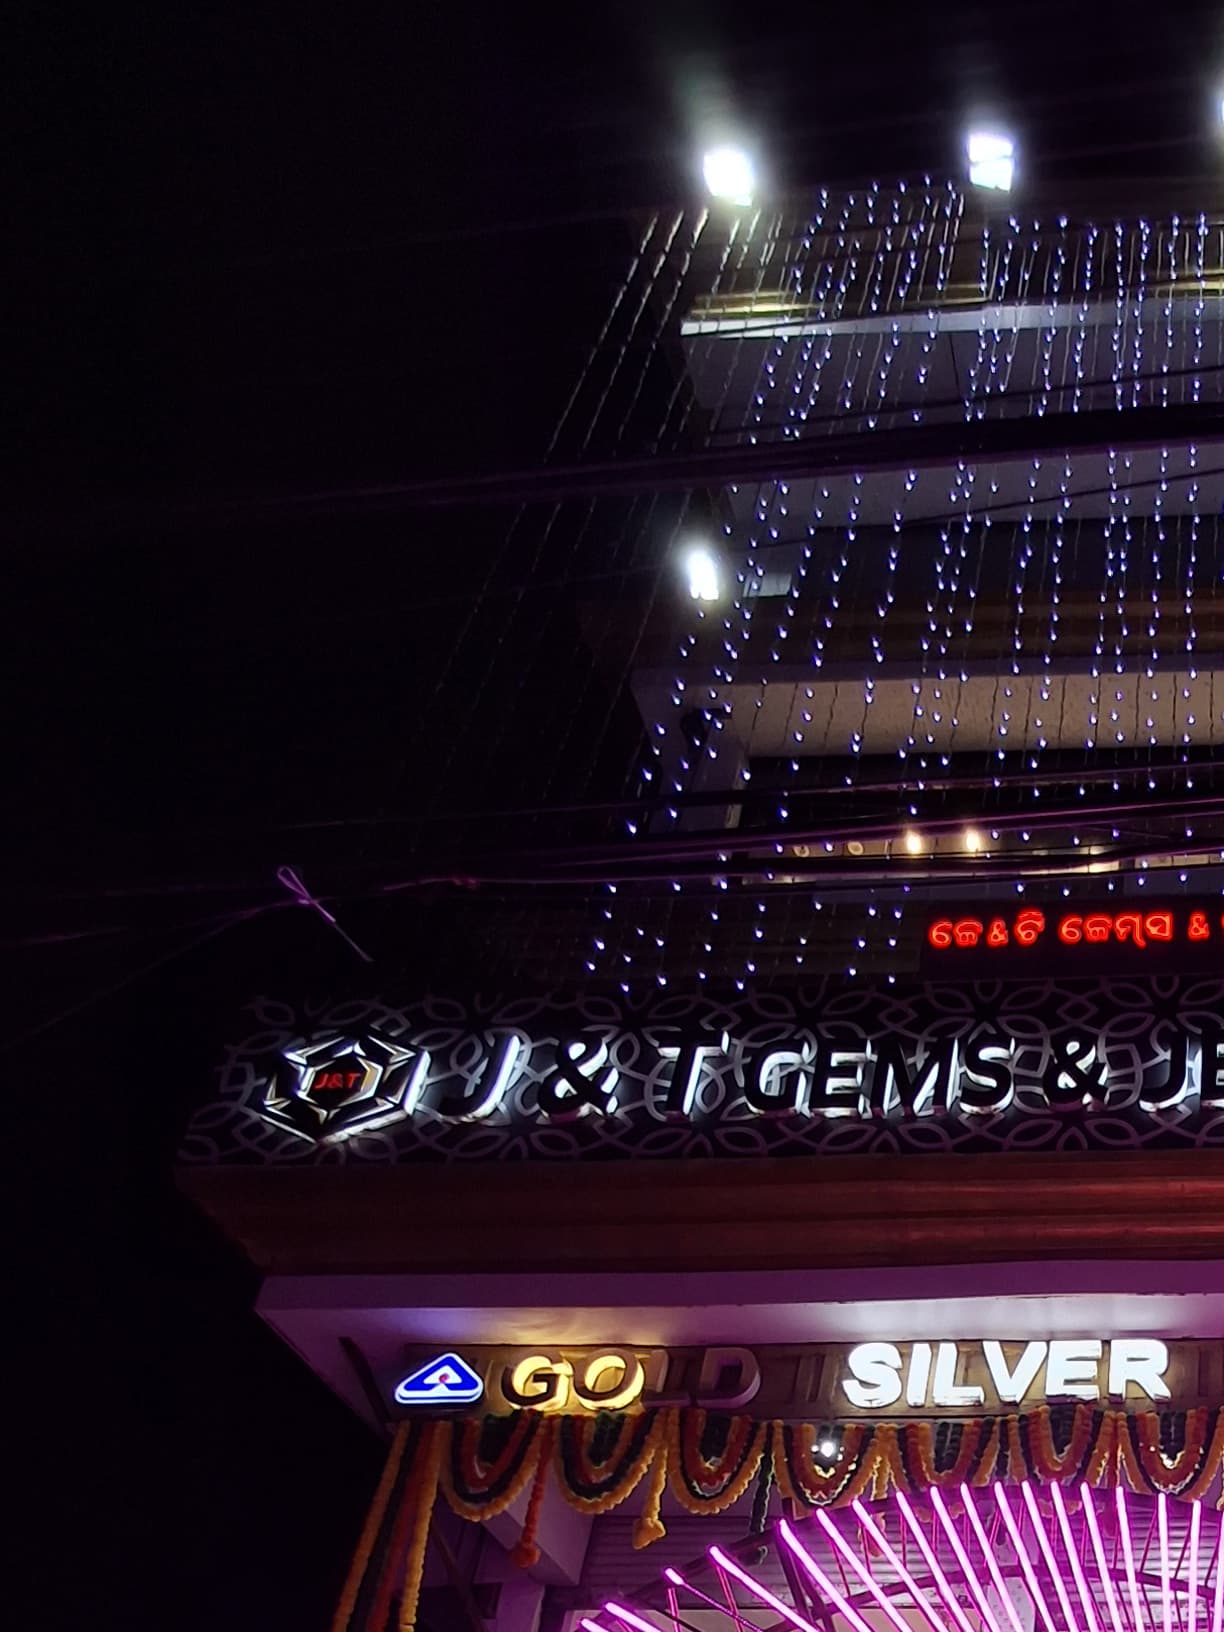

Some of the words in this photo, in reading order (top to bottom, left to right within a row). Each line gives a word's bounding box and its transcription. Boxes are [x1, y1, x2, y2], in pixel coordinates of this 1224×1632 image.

[1188, 911, 1210, 940] &
[438, 1033, 522, 1123] J
[540, 1037, 620, 1119] &
[656, 1029, 732, 1118] T
[742, 1035, 1016, 1119] GEMS
[1042, 1038, 1108, 1111] &
[501, 1347, 761, 1411] GOLD
[842, 1338, 1171, 1408] SILVER
